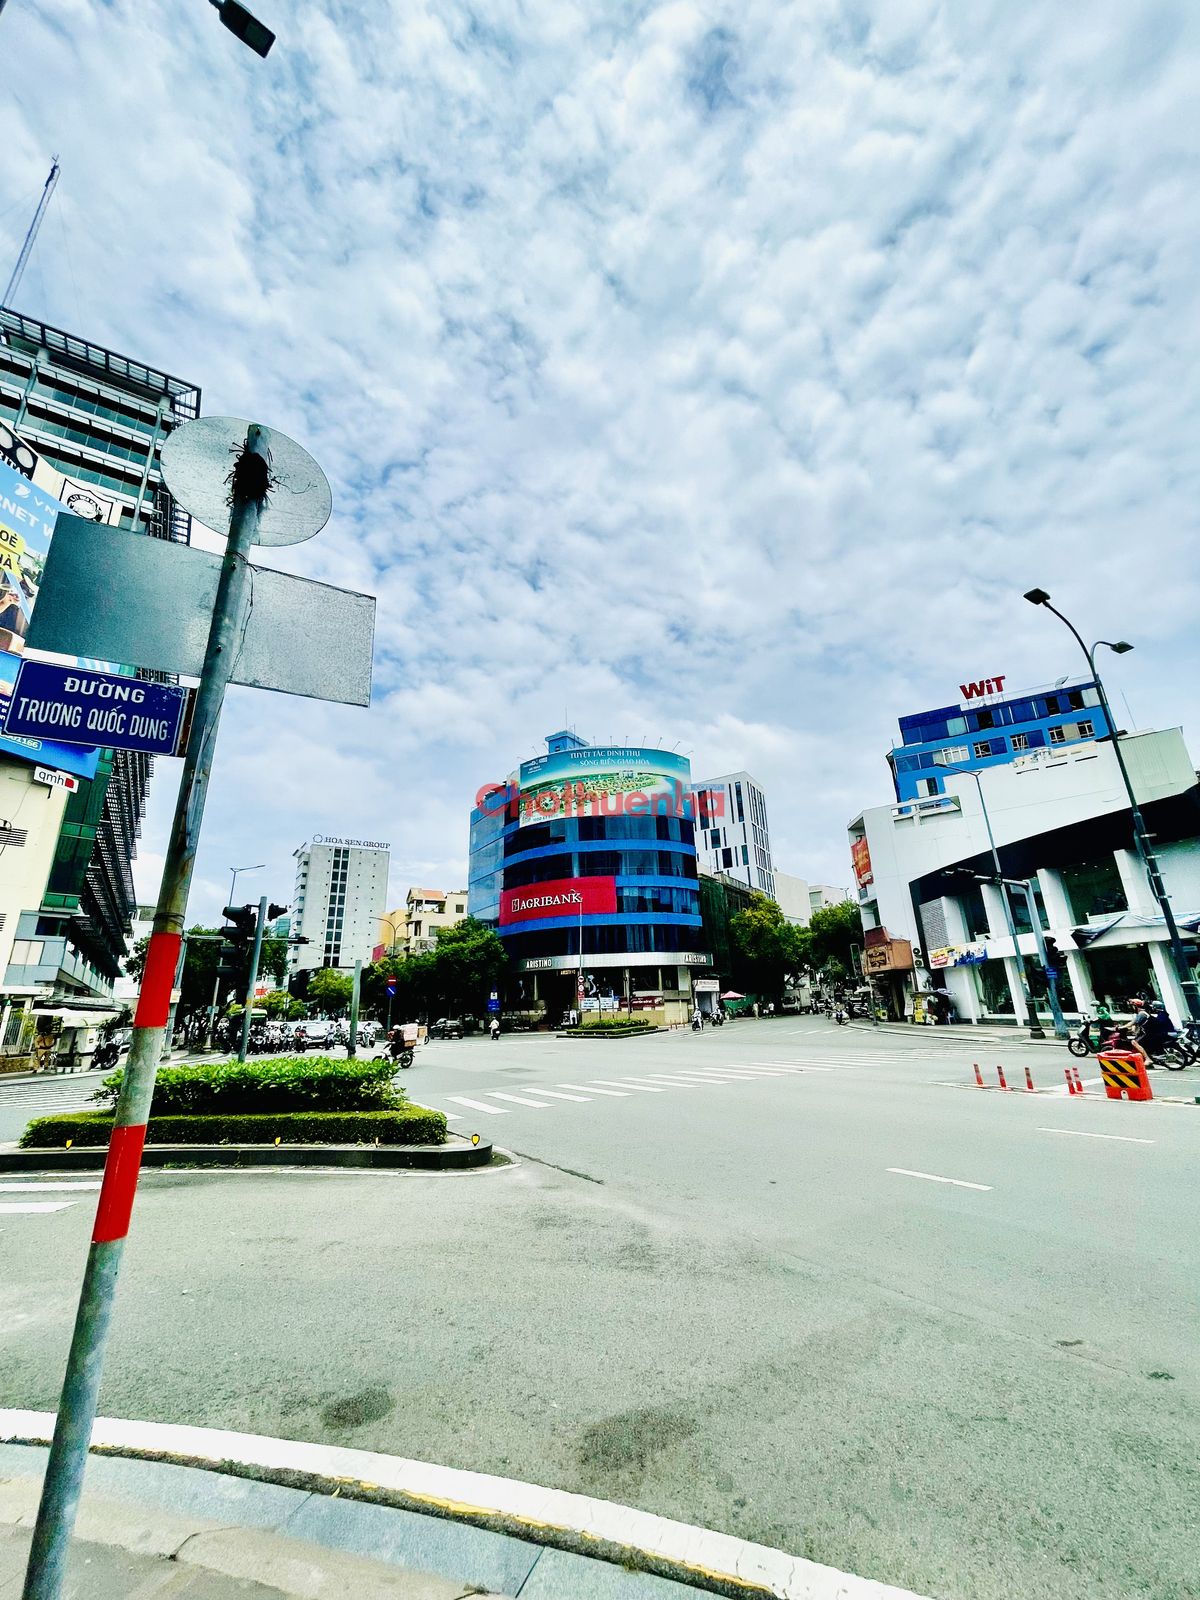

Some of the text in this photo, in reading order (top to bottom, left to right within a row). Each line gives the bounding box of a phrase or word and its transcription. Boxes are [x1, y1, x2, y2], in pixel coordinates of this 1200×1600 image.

[0, 494, 39, 528] NET
[64, 677, 145, 703] ĐƯỜNG
[17, 697, 82, 728] TRƯƠNG
[87, 705, 126, 735] QUỐC
[129, 715, 169, 741] DUNG
[38, 770, 64, 786] qmh
[325, 836, 343, 844] HOA
[363, 841, 391, 849] GROUP
[520, 891, 583, 910] AGRIBANK
[525, 959, 552, 968] ARISTINO
